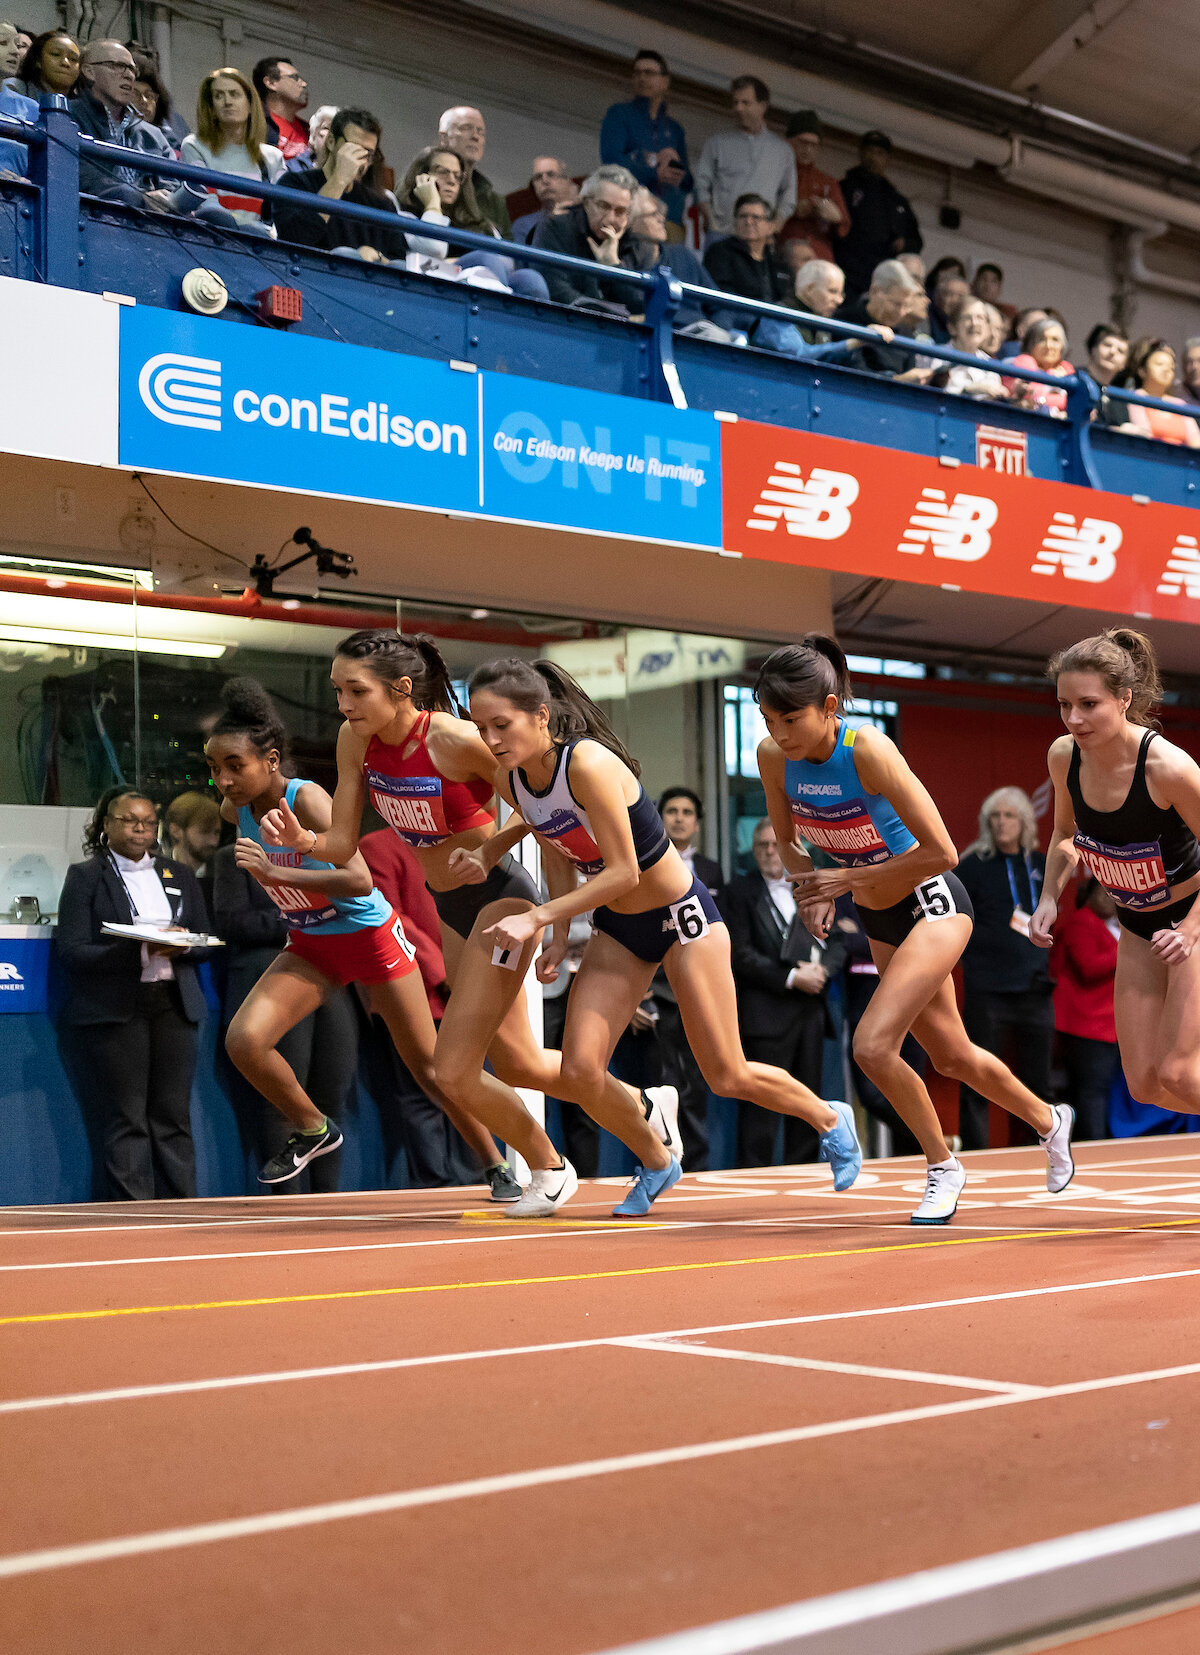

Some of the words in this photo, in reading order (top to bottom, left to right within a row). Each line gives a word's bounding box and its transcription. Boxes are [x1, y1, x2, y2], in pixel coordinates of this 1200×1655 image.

[232, 389, 467, 456] conEdison
[493, 431, 523, 453] Con
[526, 437, 576, 463] Edison
[578, 446, 623, 472] Keeps
[626, 454, 645, 474] Us
[647, 457, 707, 487] Running.
[496, 411, 611, 494] ON
[644, 435, 710, 508] IT
[979, 443, 1024, 477] EXIT
[797, 783, 829, 796] HOKA
[374, 792, 438, 832] WERNER
[266, 852, 303, 867] EXICO
[920, 880, 950, 916] 5
[677, 903, 703, 939] 6
